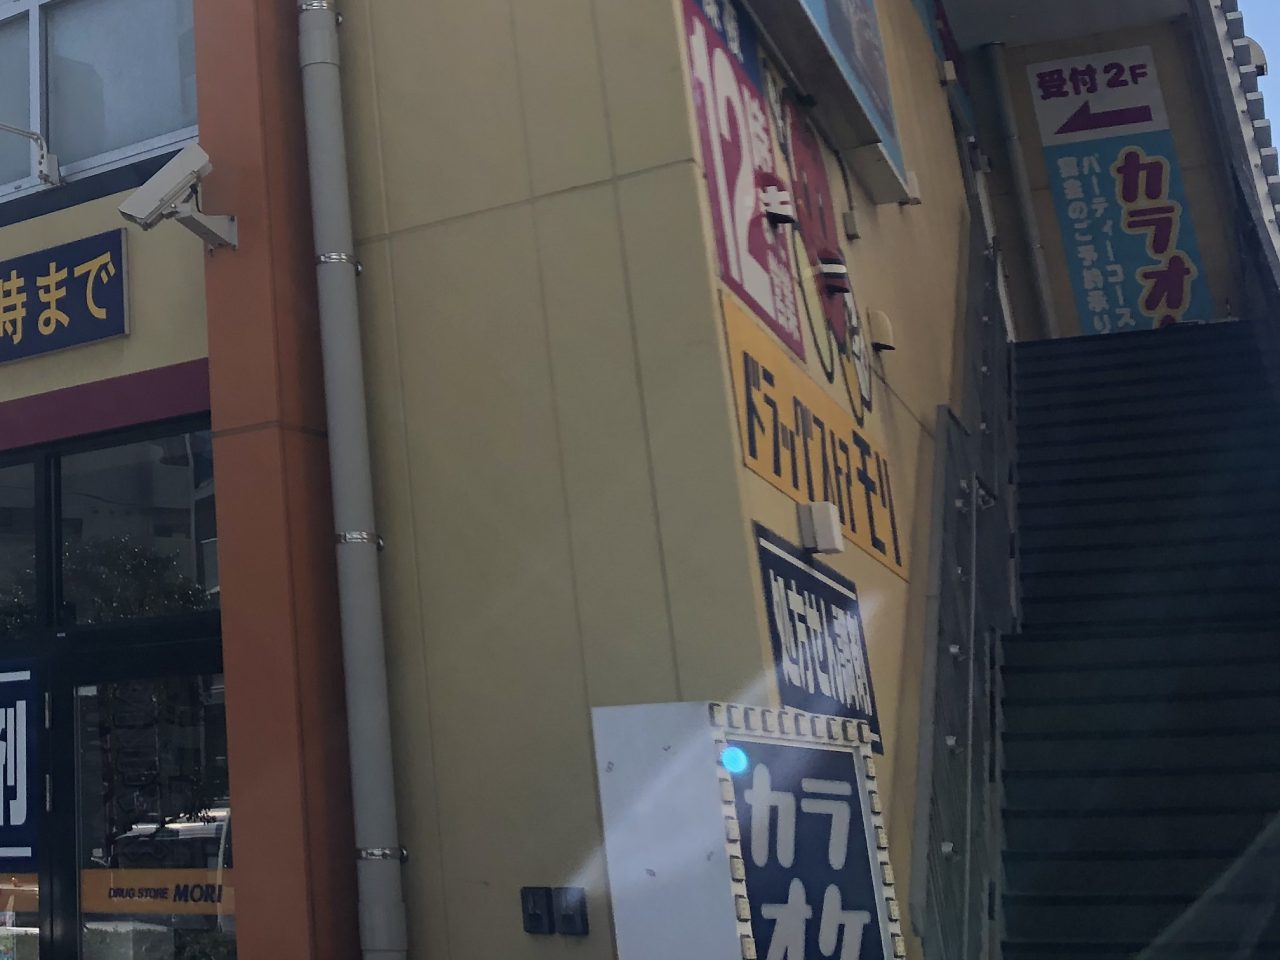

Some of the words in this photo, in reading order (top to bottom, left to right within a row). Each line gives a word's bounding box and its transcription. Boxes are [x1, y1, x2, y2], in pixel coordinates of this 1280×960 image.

[1036, 62, 1147, 100] 受付2F
[1116, 150, 1191, 329] カラオ
[743, 350, 902, 568] ドラッグストアモリ
[744, 763, 852, 870] カラ
[137, 887, 169, 899] STORE
[173, 884, 223, 903] MORI
[761, 878, 870, 960] オケ
